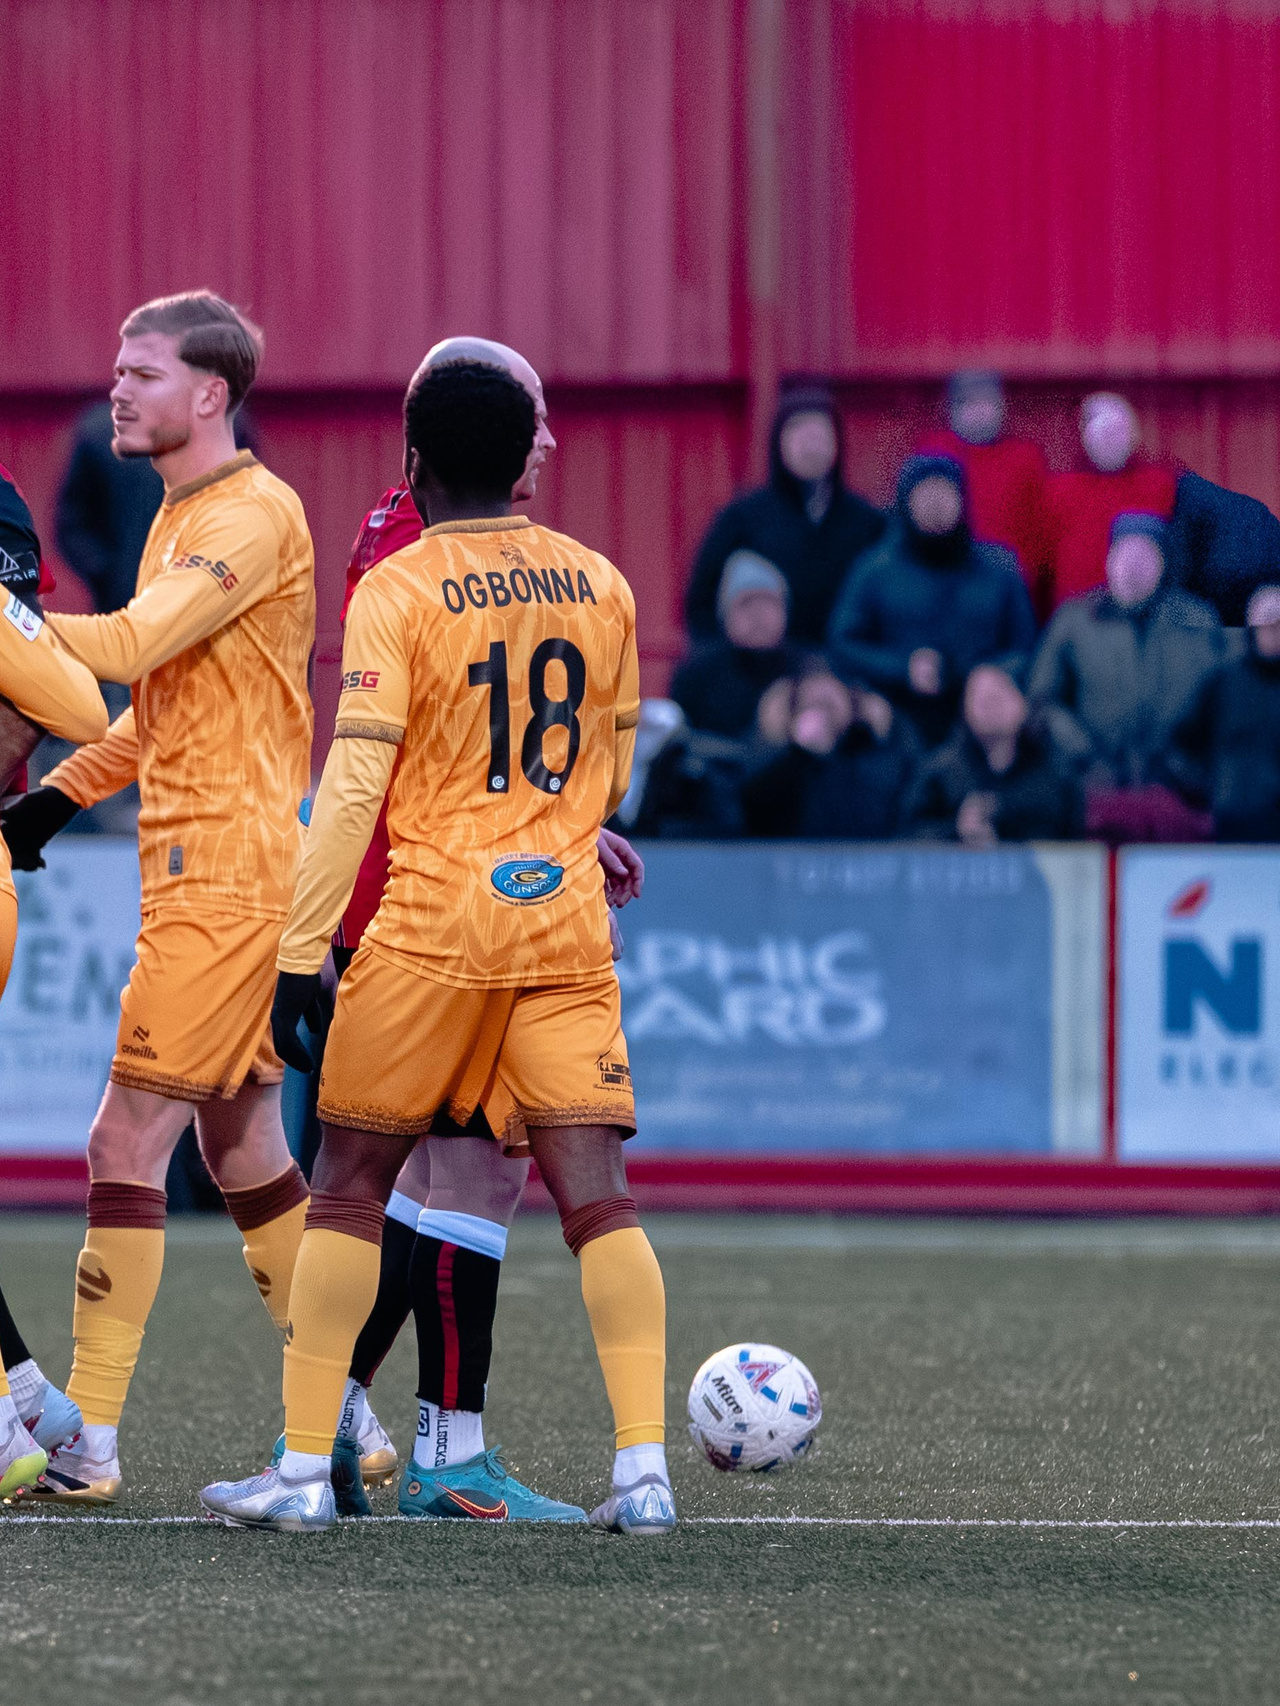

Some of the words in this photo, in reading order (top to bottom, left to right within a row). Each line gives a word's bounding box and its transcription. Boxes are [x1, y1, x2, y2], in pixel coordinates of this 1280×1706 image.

[442, 568, 597, 614] OGBONNA
[468, 637, 586, 795] 18
[711, 1375, 743, 1414] Mitre
